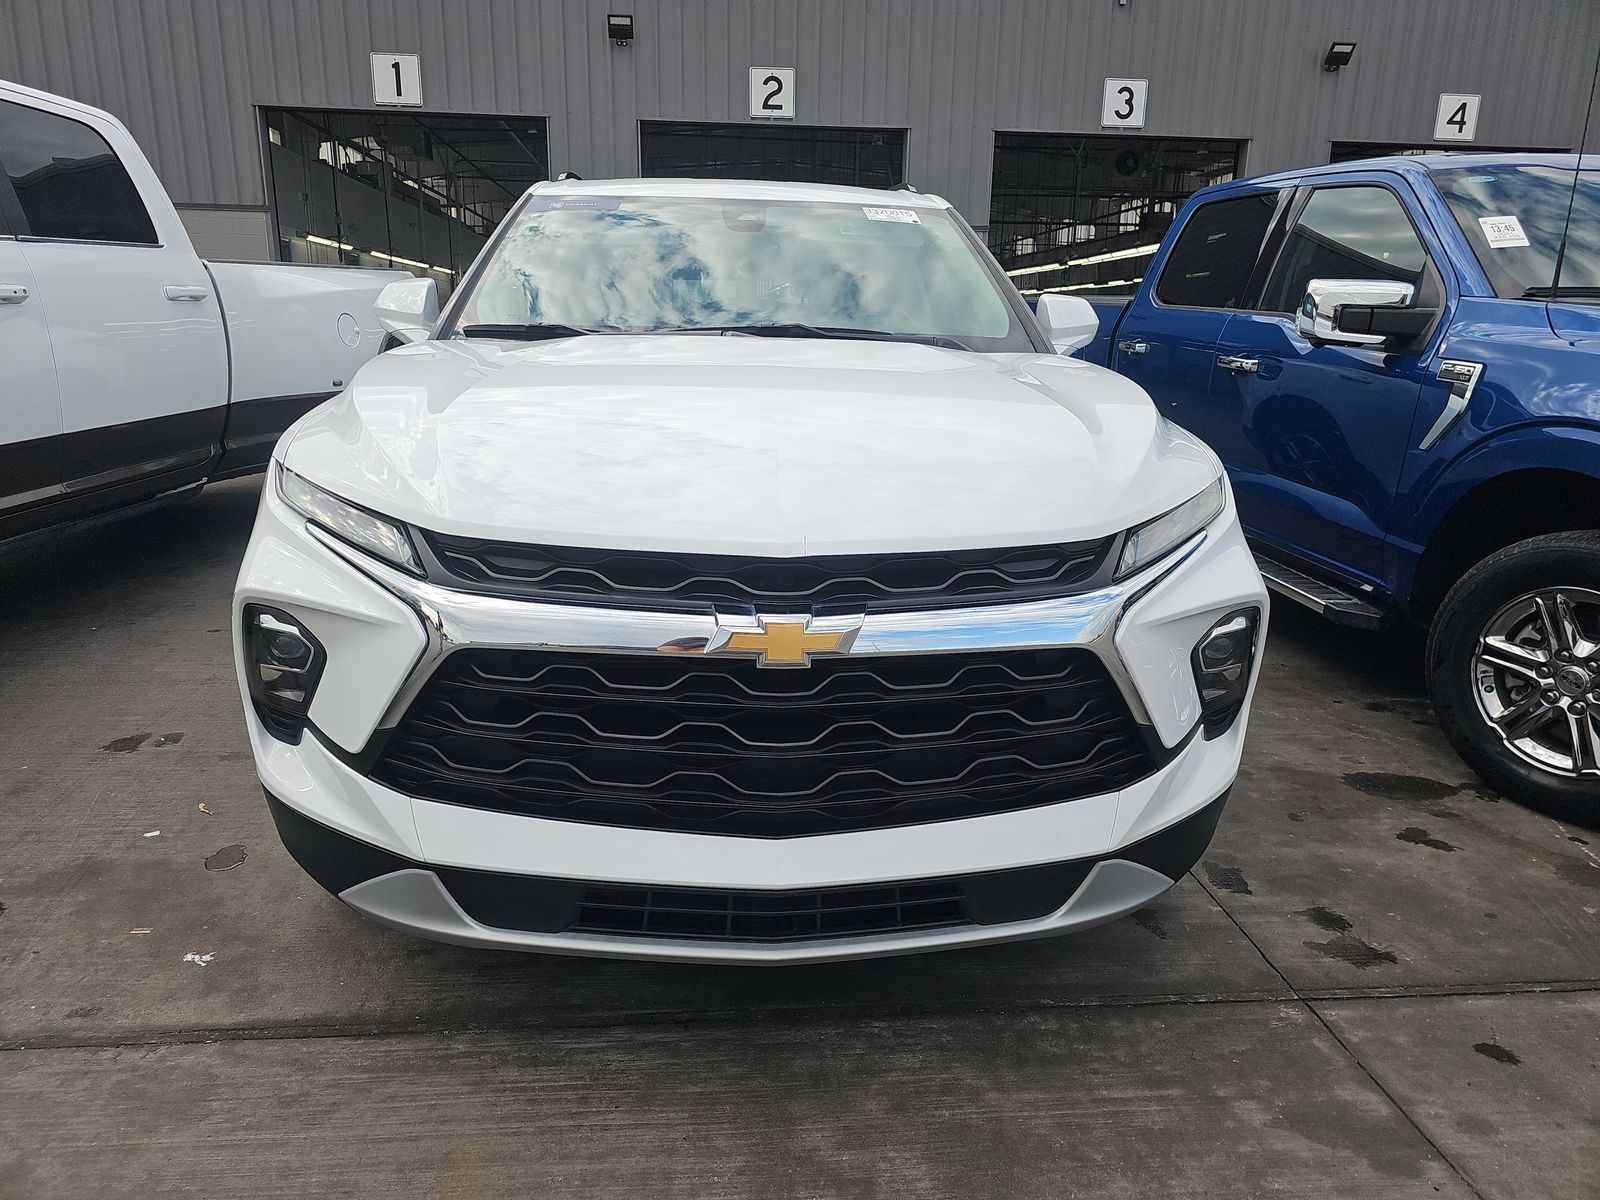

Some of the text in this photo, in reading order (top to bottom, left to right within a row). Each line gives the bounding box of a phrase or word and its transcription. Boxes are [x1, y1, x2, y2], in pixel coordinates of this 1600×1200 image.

[391, 61, 403, 97] 1
[762, 76, 784, 111] 2
[1114, 86, 1135, 120] 3
[1446, 102, 1468, 134] 4
